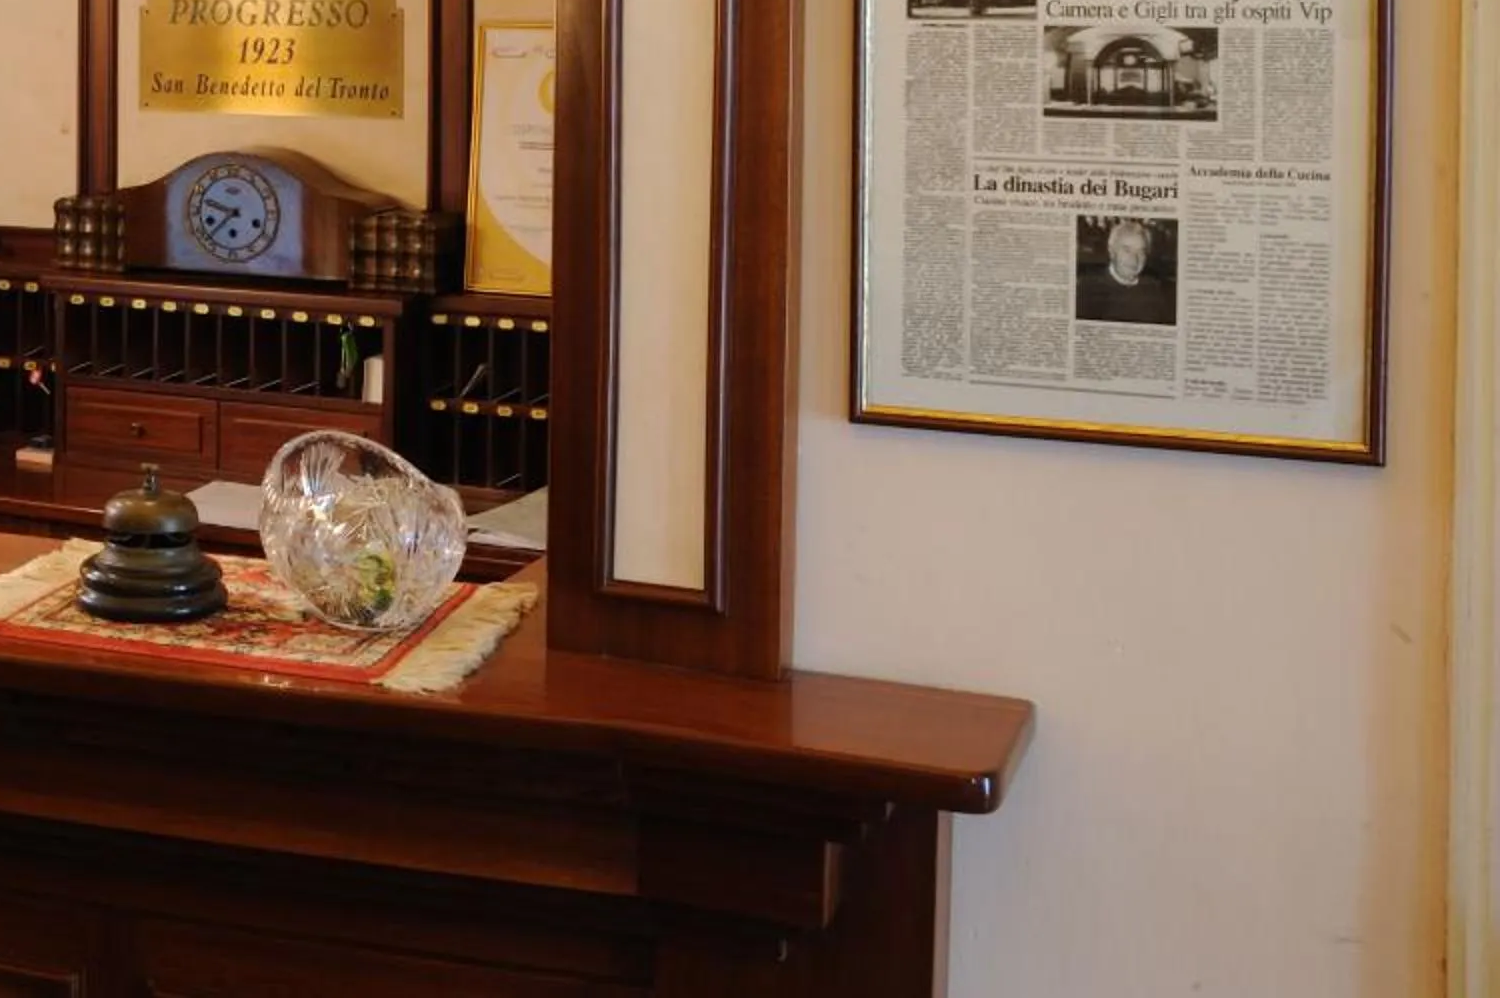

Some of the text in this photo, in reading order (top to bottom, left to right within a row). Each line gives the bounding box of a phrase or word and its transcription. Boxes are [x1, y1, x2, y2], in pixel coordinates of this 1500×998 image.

[1117, 5, 1128, 19] e
[1134, 0, 1178, 24] Gigli
[1184, 1, 1207, 20] tra
[1213, 0, 1236, 24] gli
[1241, 1, 1291, 24] ospiti
[1299, 1, 1333, 24] Vip
[239, 37, 297, 65] 1923
[150, 71, 390, 100] San Benedetto del Tronto
[974, 173, 1178, 202] La dinastia dei Bugari
